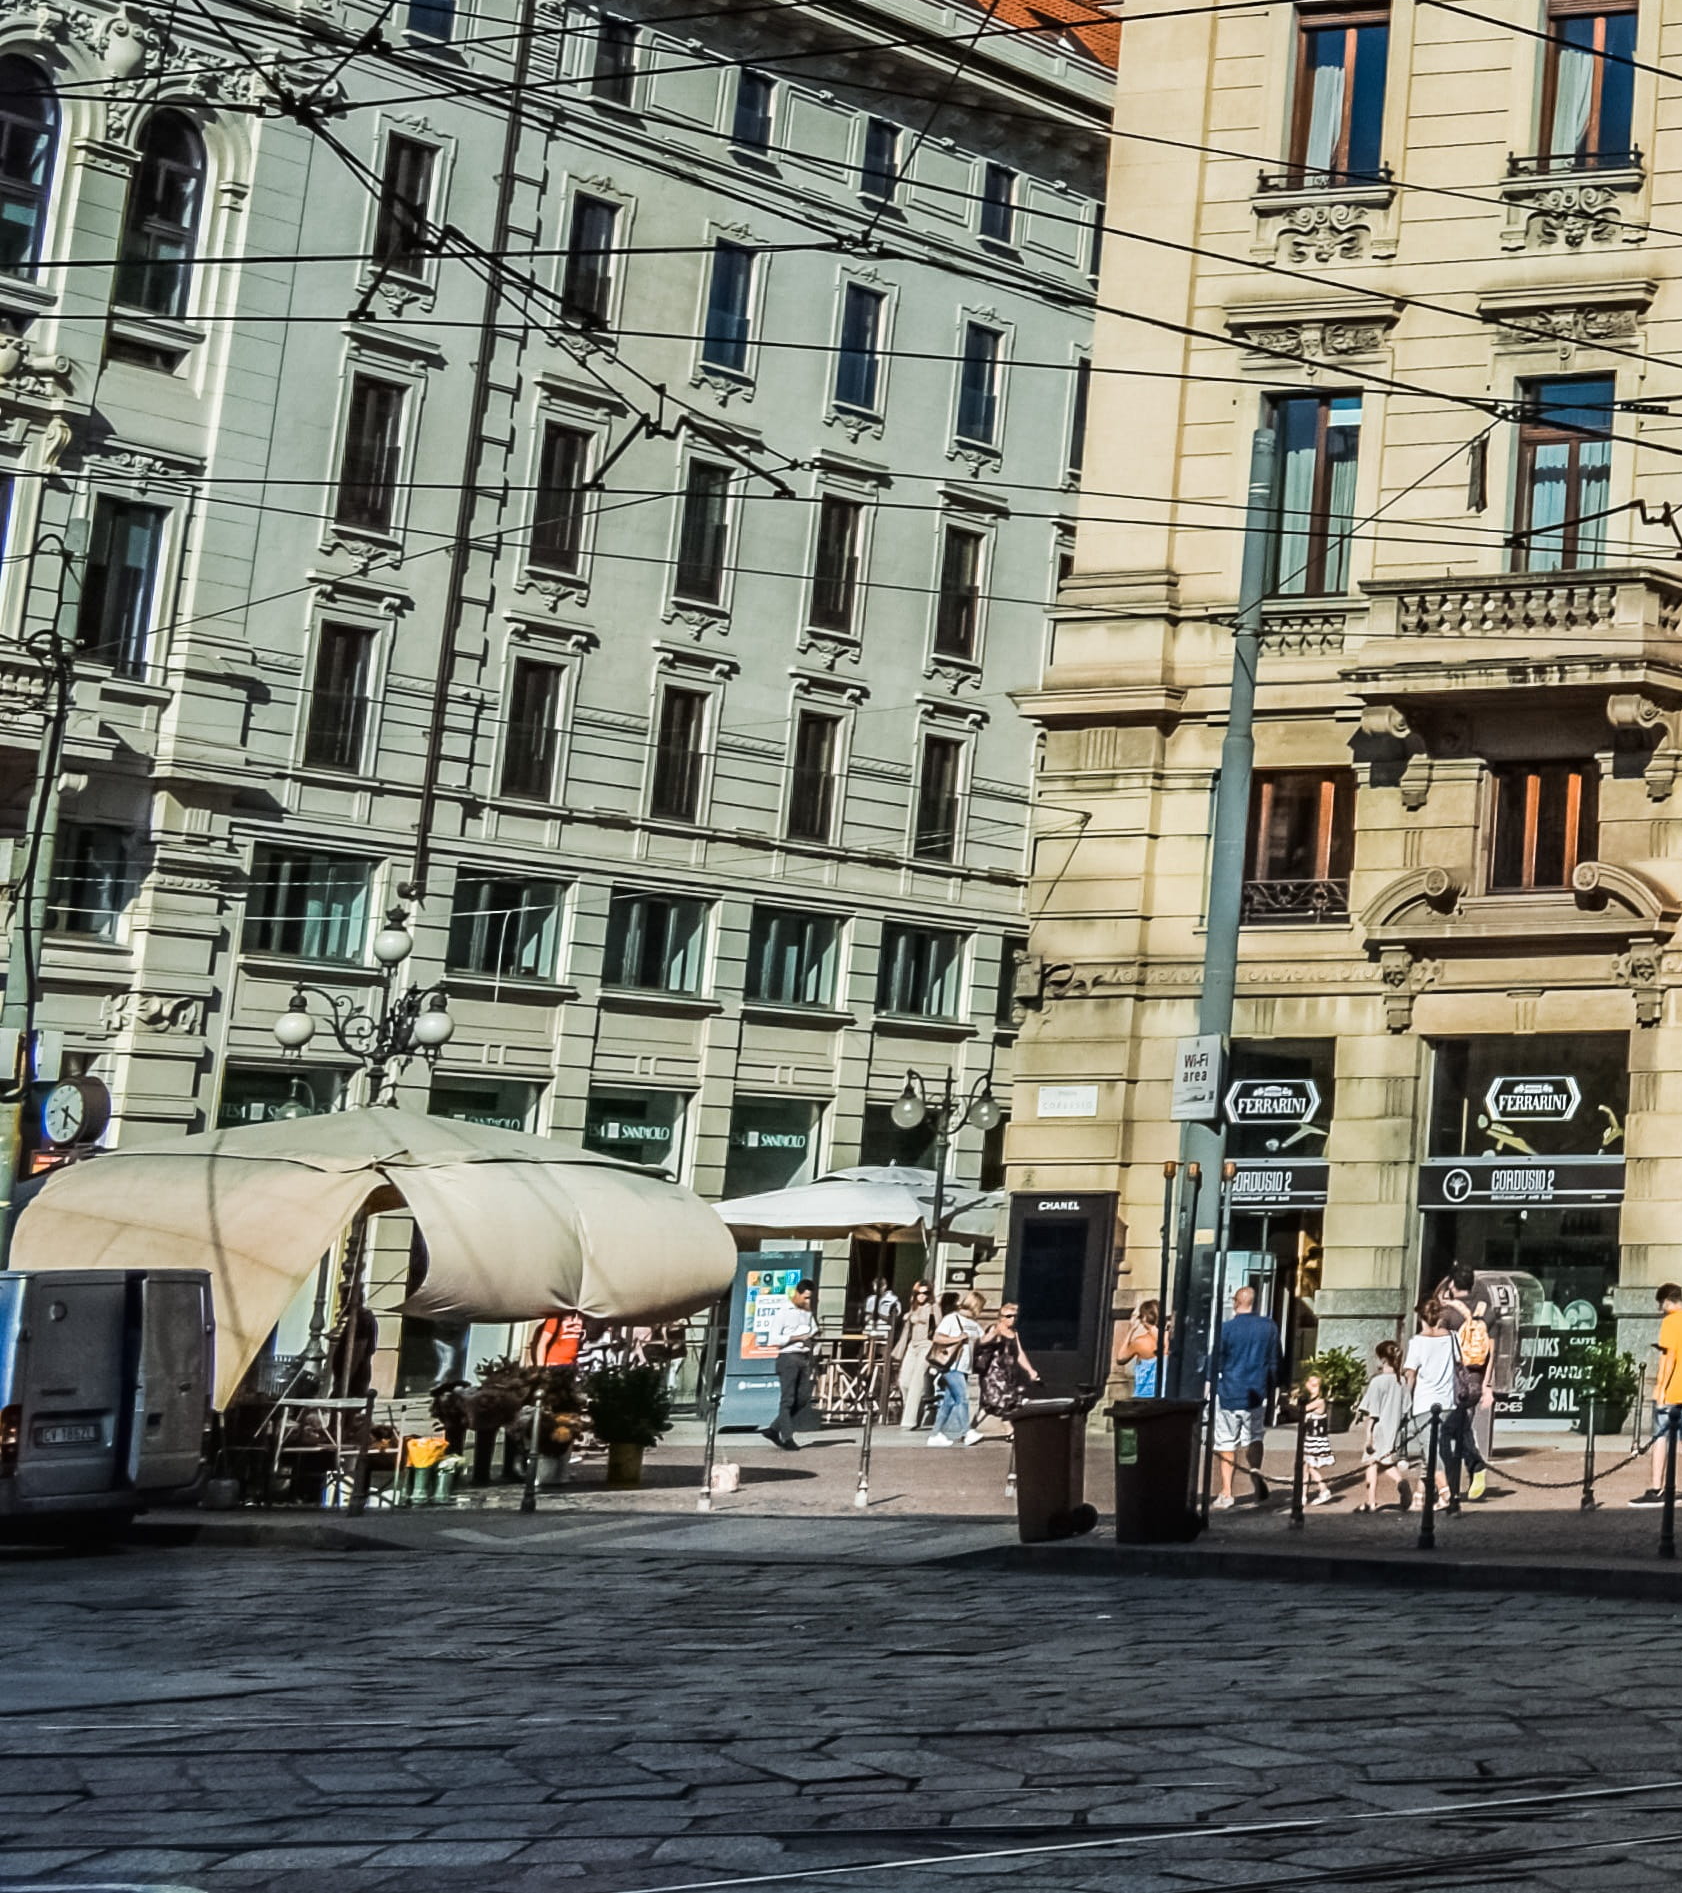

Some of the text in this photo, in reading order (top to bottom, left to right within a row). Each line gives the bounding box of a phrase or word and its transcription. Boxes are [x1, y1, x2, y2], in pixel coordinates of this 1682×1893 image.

[1184, 1053, 1209, 1069] Wi-Fi
[1183, 1070, 1208, 1083] area
[1237, 1097, 1307, 1115] FERRARINI
[1499, 1093, 1568, 1111] FERRARINI
[1285, 1171, 1292, 1192] 2
[1491, 1169, 1555, 1191] CORDUSIO 2
[1038, 1201, 1080, 1211] CHANEL
